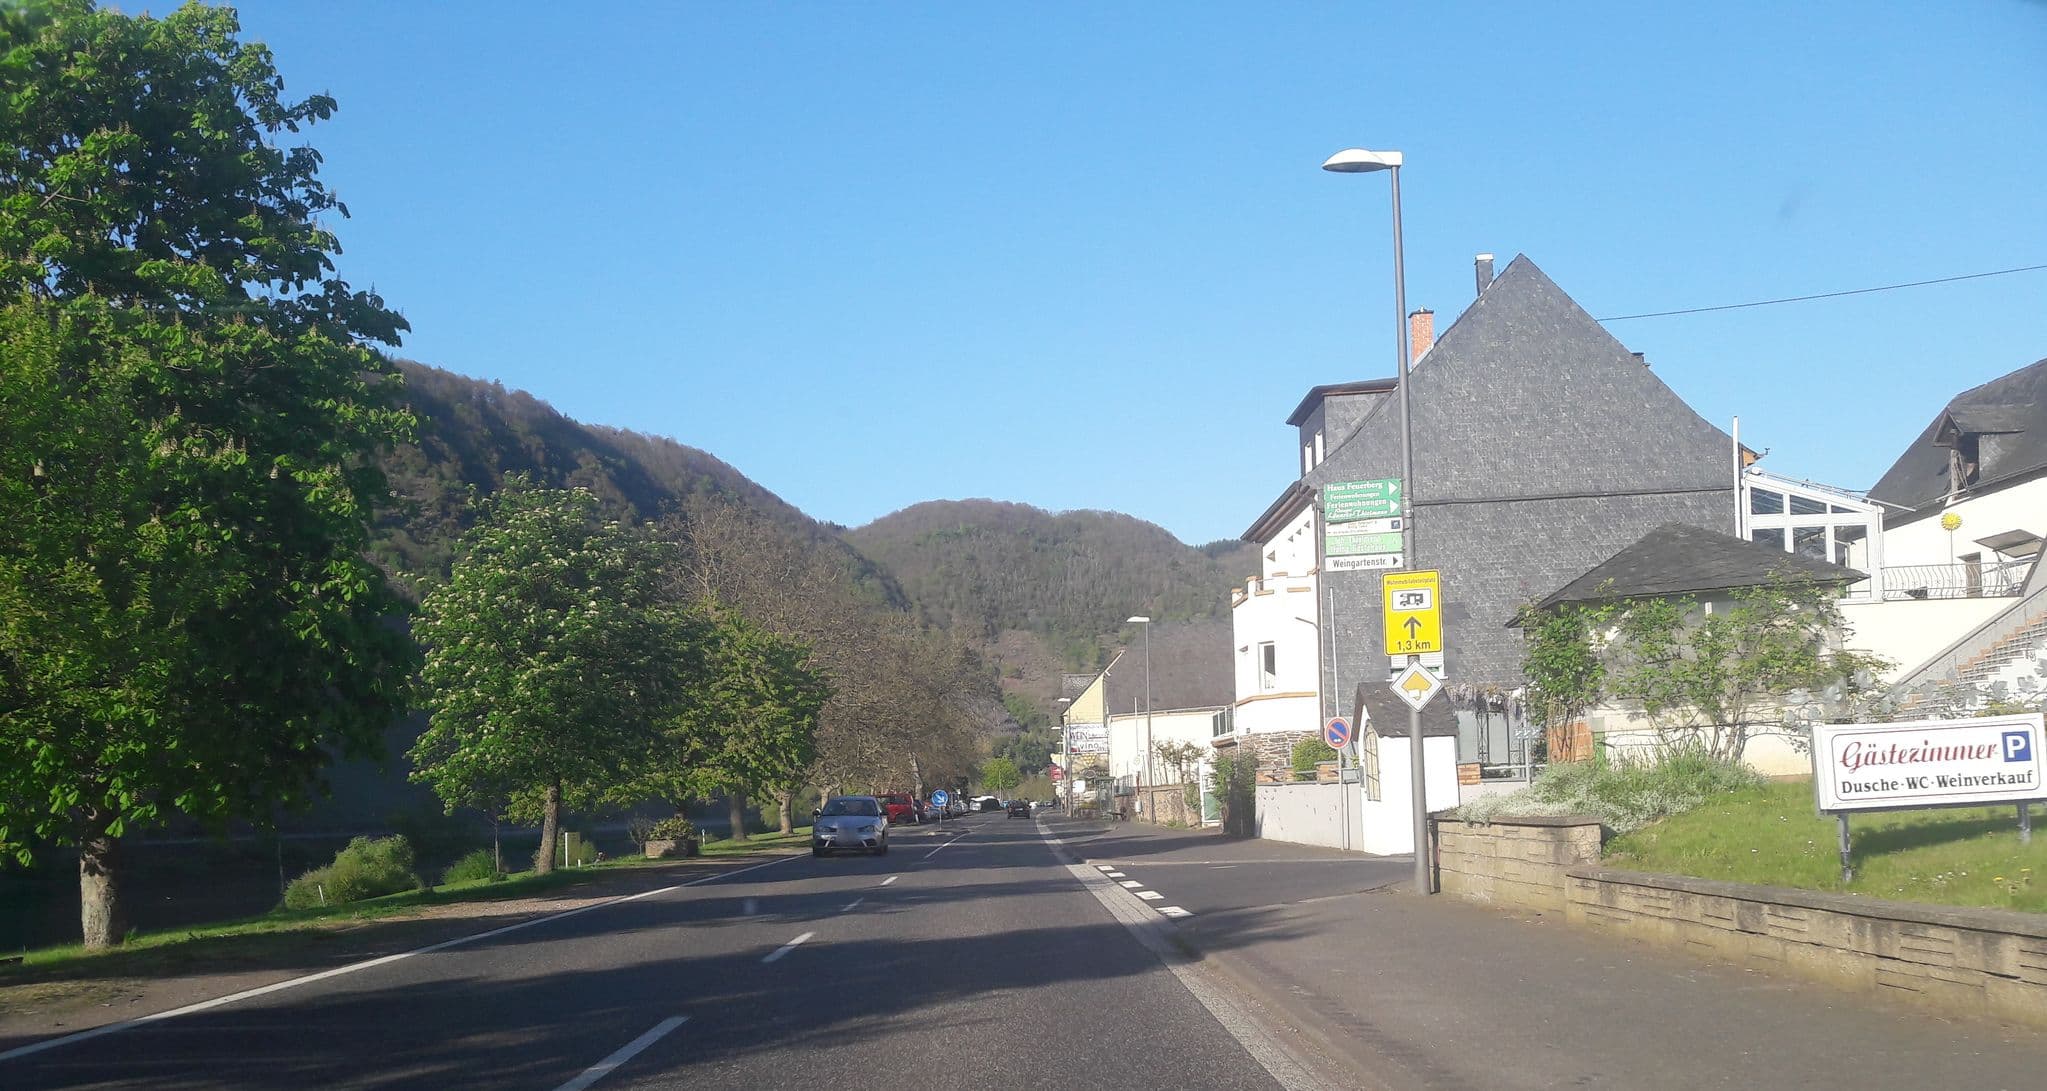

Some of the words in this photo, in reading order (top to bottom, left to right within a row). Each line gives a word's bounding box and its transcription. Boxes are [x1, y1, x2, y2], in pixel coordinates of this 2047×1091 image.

[1327, 484, 1345, 492] Haus
[1347, 482, 1383, 490] Feuerberg
[1330, 492, 1380, 501] Ferienwohnungen
[1326, 499, 1387, 509] Ferienwohnungen
[1396, 640, 1412, 652] 1,3
[1415, 639, 1431, 650] km
[1839, 739, 1998, 774] Gästezimmer
